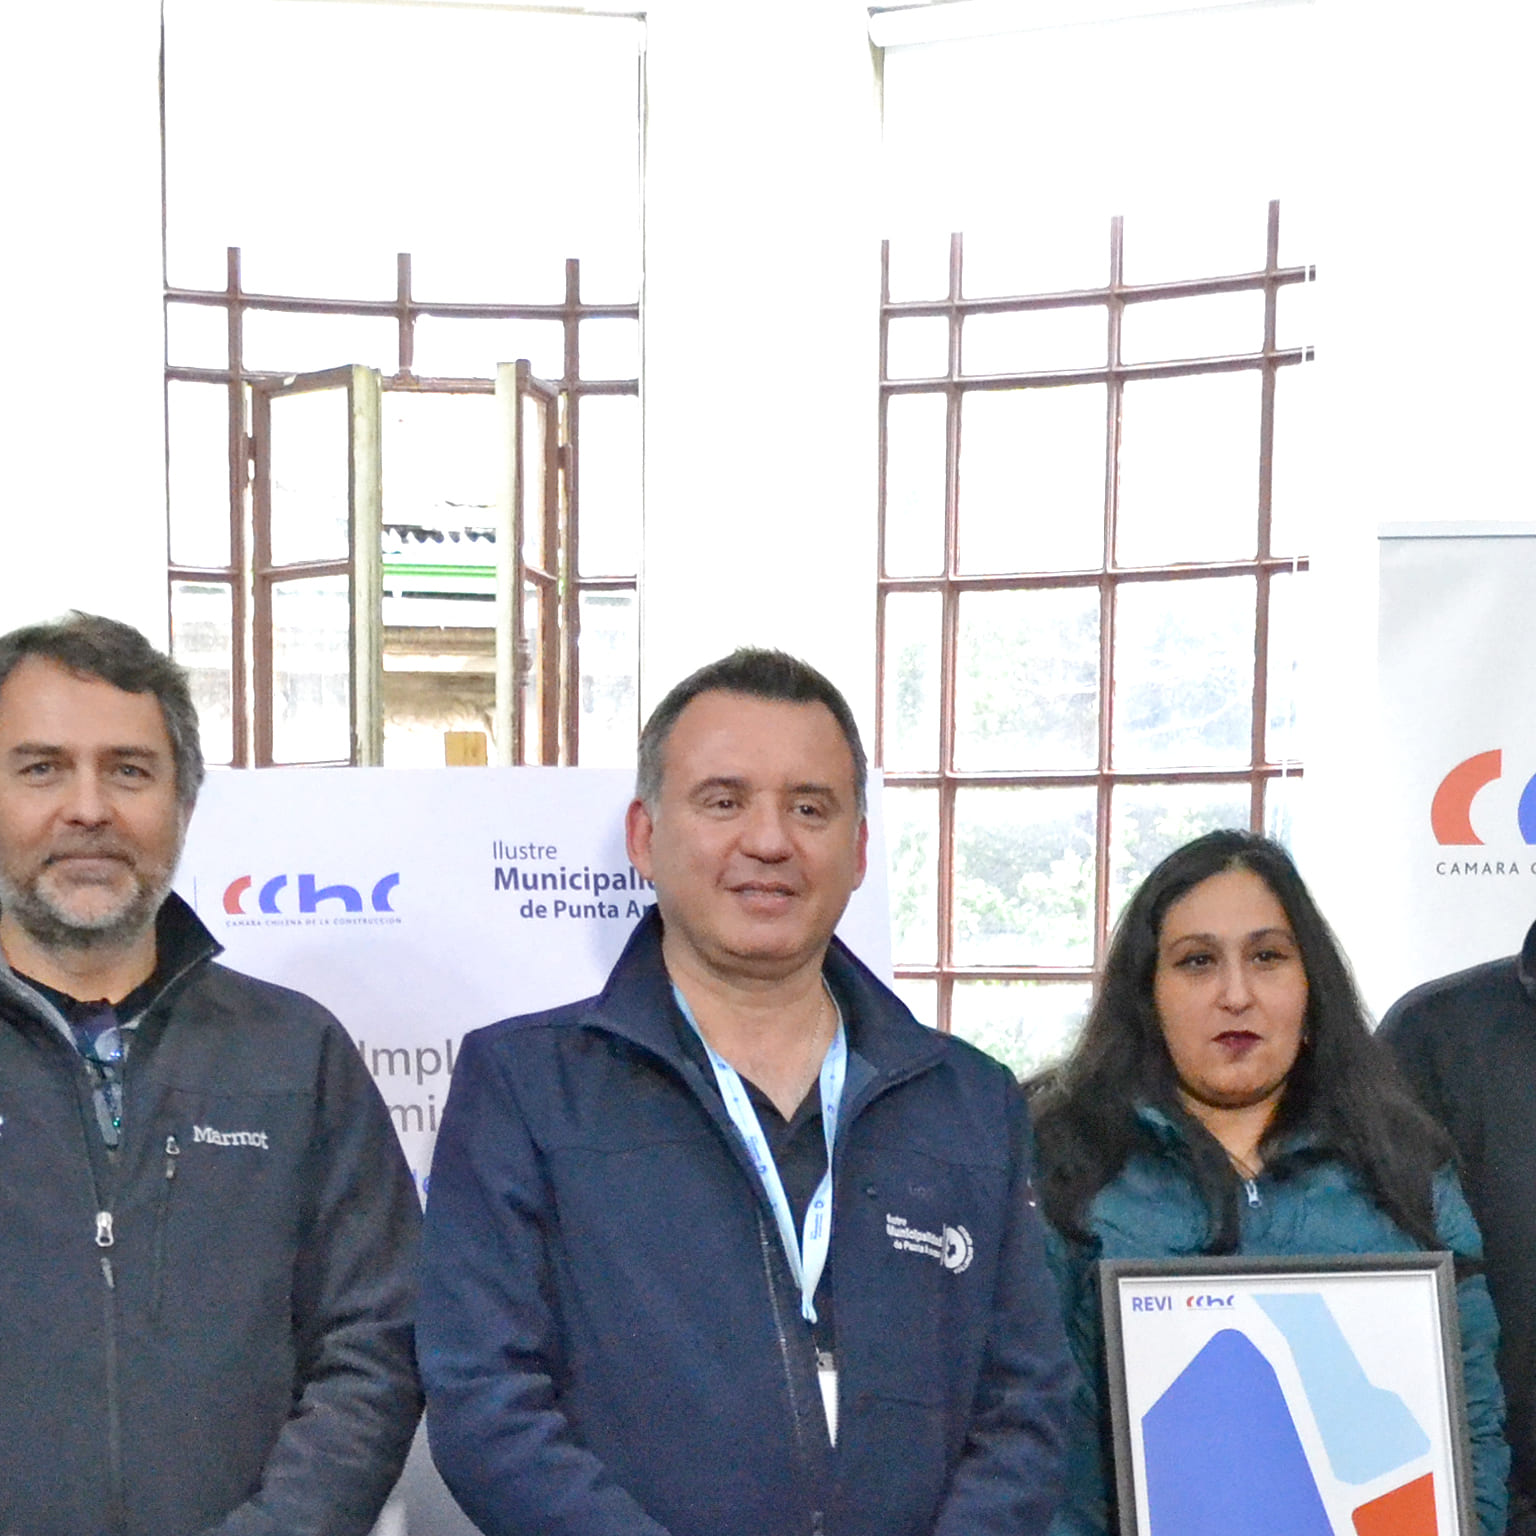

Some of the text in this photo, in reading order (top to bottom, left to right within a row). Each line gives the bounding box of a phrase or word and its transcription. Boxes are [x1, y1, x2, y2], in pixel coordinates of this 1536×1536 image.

[492, 840, 557, 860] Ilustre
[1436, 861, 1520, 876] CAMARA
[519, 899, 548, 919] de
[553, 899, 619, 919] Punta
[193, 1125, 269, 1150] Marmot
[1132, 1295, 1173, 1312] REVI
